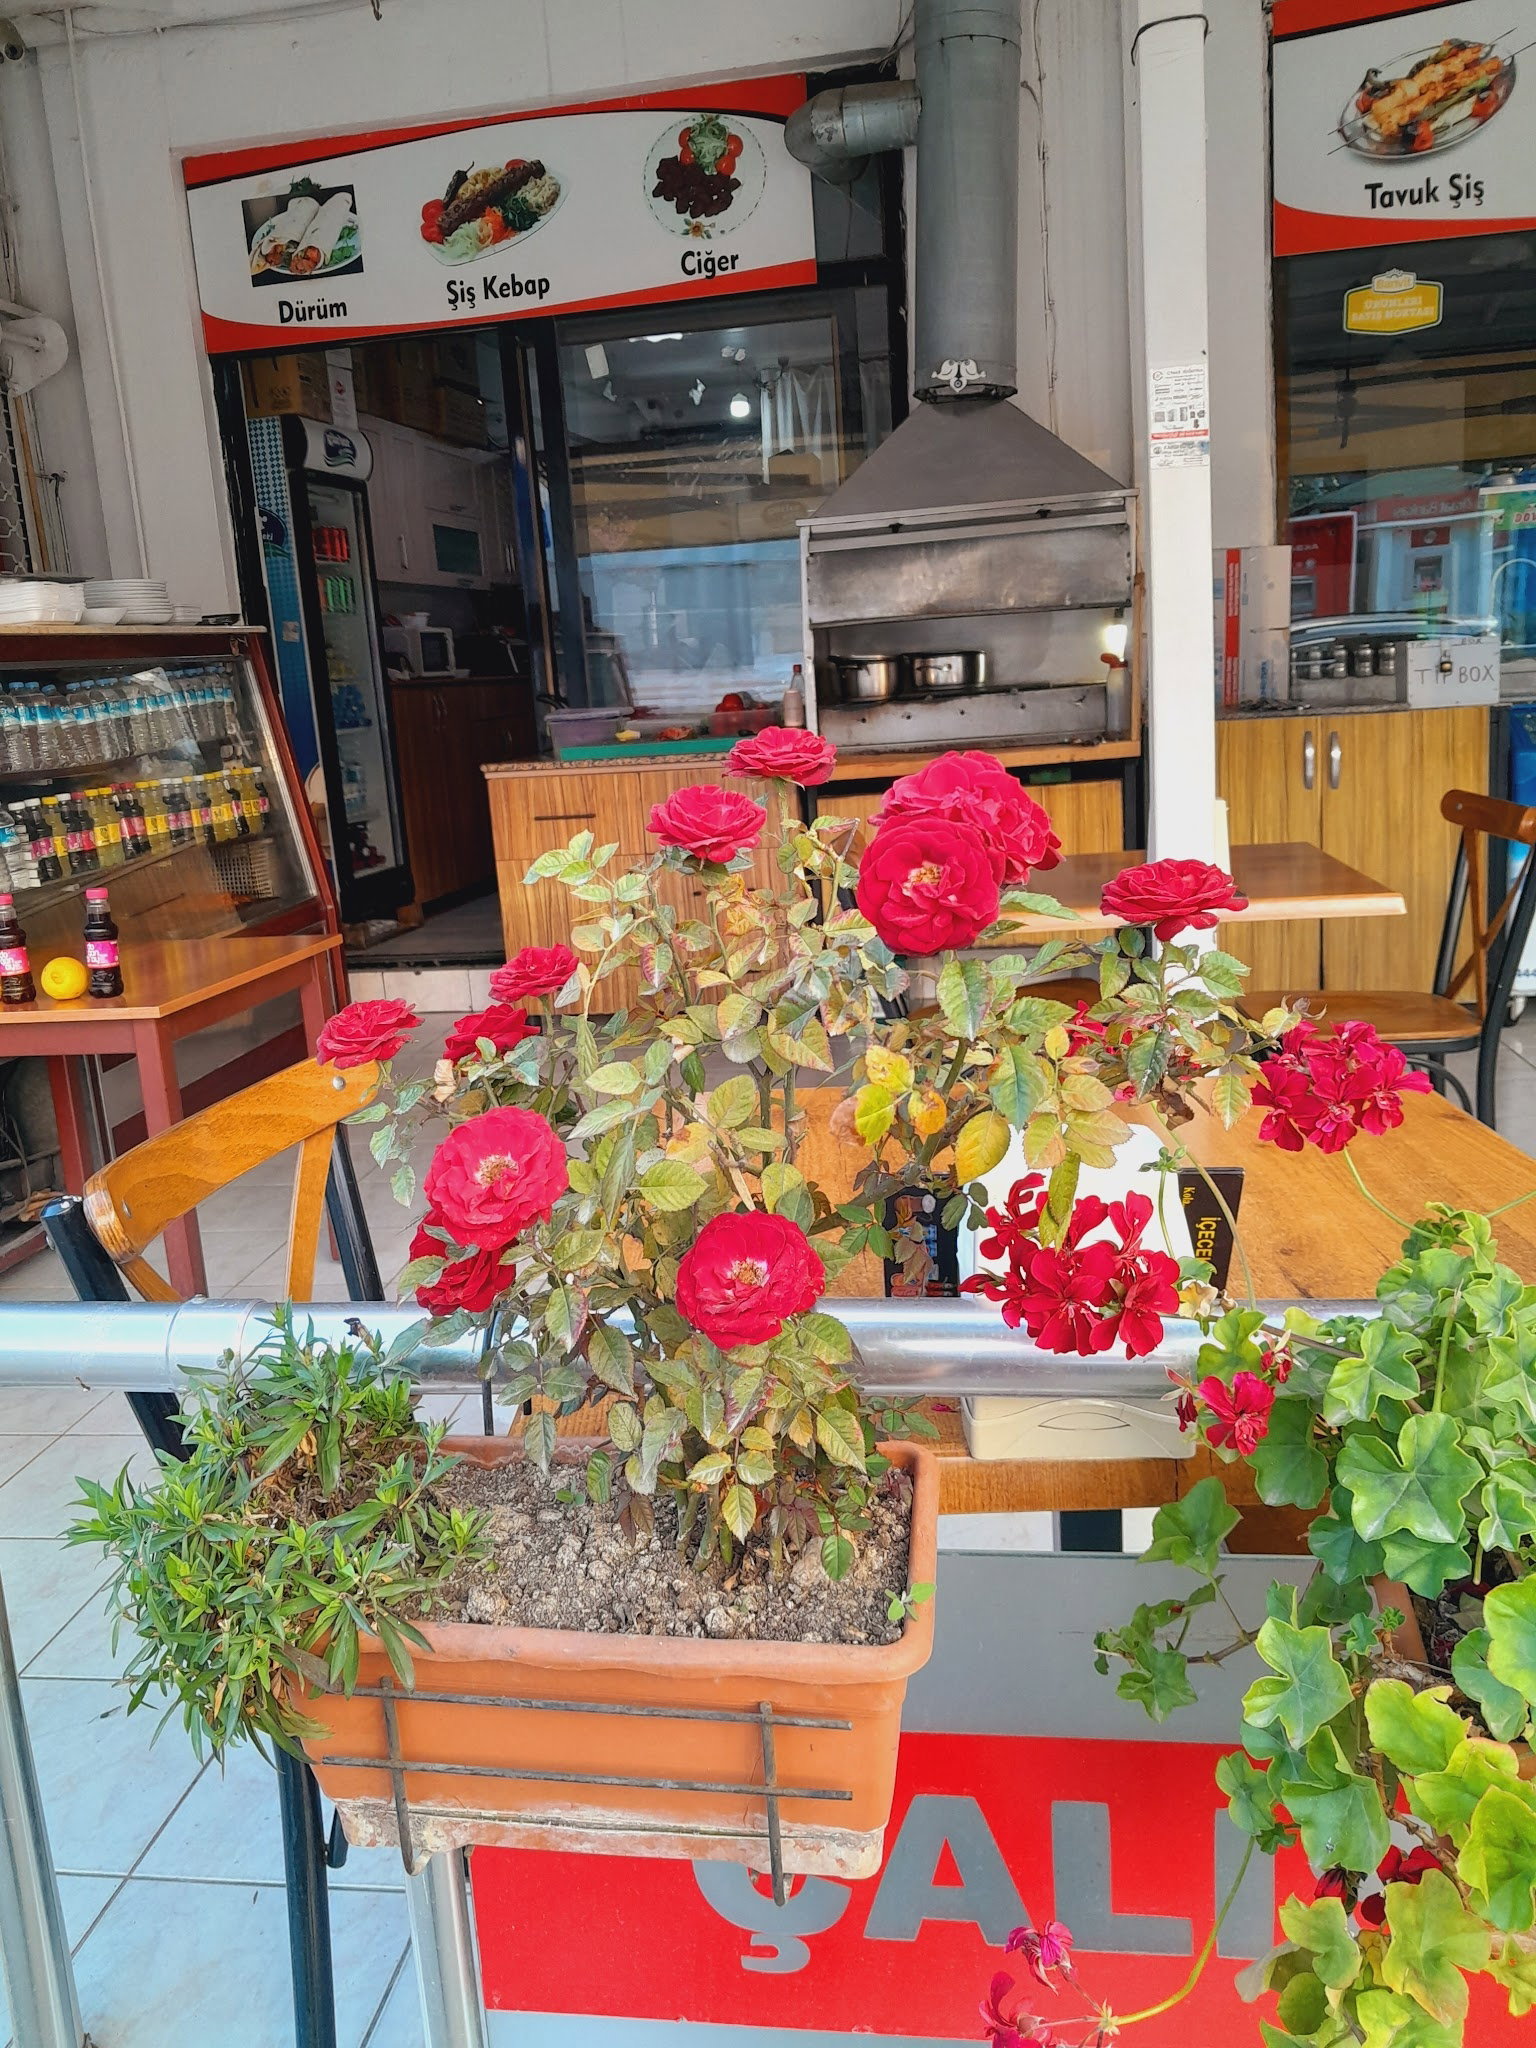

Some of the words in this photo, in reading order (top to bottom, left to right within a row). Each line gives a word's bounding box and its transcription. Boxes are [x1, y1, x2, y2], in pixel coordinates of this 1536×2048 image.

[1364, 176, 1440, 209] Tavuk
[1448, 173, 1485, 209] Şiş
[681, 249, 739, 280] Ciğer
[446, 279, 476, 311] Şiş
[482, 273, 550, 300] Kebap
[278, 297, 348, 324] Dürüm
[1458, 664, 1496, 684] BOX
